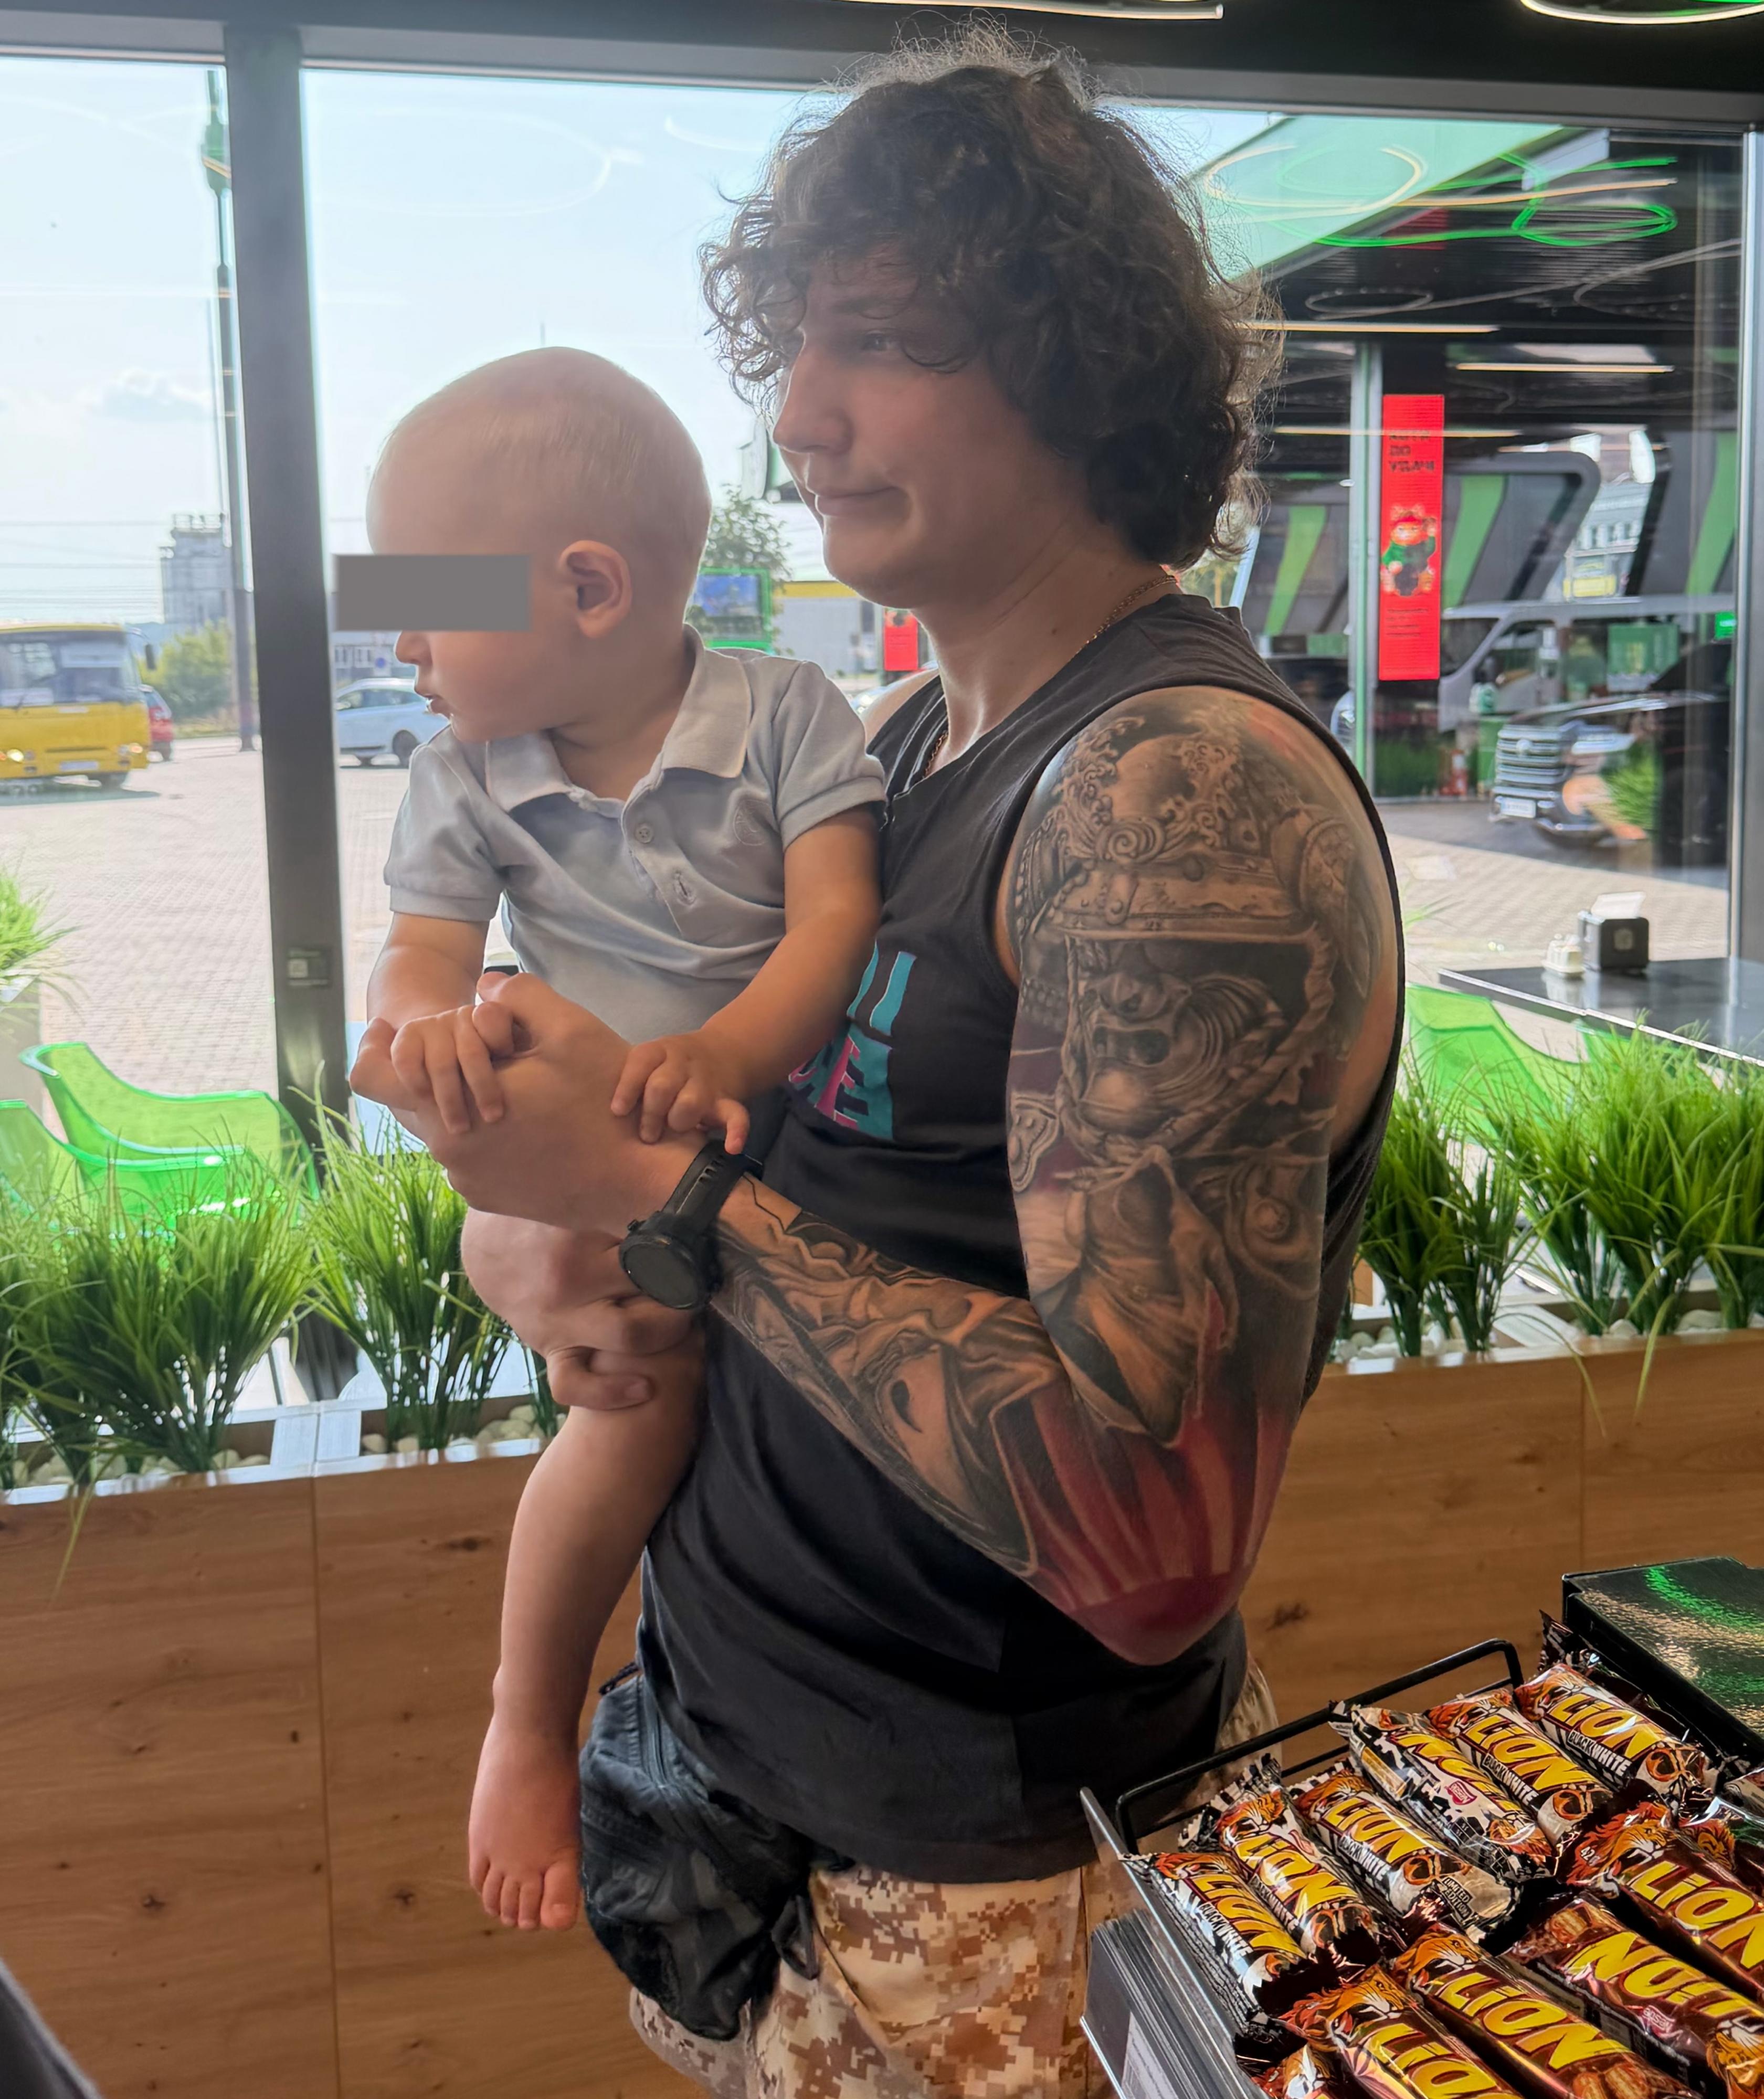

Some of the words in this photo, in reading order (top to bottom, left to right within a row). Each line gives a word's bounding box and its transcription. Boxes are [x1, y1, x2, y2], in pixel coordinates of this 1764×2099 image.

[1464, 1714, 1598, 1791] LION
[1548, 1692, 1666, 1759] LION
[1324, 1797, 1445, 1862] LION
[1234, 1833, 1359, 1916] LION
[1444, 1878, 1470, 1904] LIMITED
[1445, 1889, 1470, 1918] EDITION
[1193, 1873, 1307, 1959] LION
[1630, 1860, 1764, 1969] LION
[1565, 1932, 1764, 2018] LION
[1439, 1971, 1632, 2069] LION
[1368, 2022, 1523, 2099] LIO
